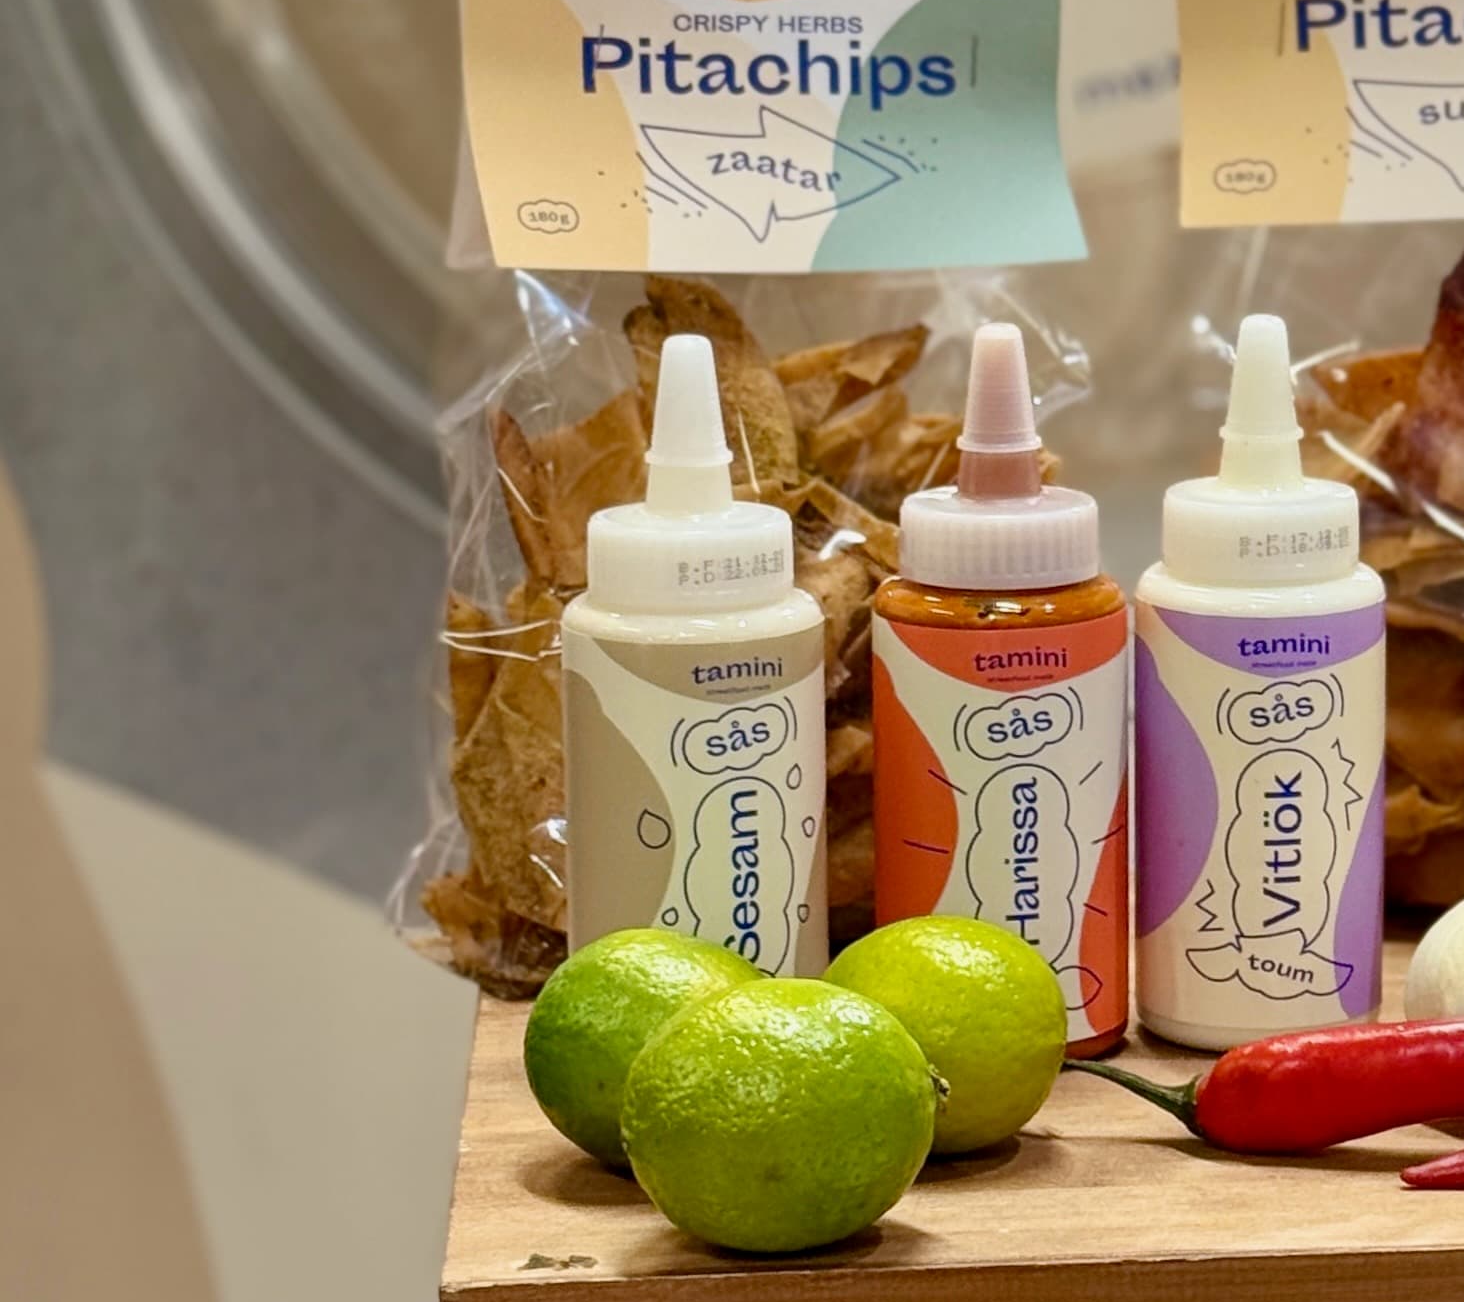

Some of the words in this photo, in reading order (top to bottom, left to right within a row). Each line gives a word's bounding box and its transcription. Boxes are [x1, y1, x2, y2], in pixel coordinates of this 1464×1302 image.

[673, 14, 769, 35] CRISPY
[778, 15, 864, 34] HERBS
[581, 36, 957, 111] Pitachips
[705, 145, 842, 194] zaatar
[974, 645, 1068, 672] tamini
[1237, 632, 1331, 657] tamini
[690, 656, 784, 685] tamini
[986, 708, 1054, 743] sås
[1249, 694, 1315, 728] sås
[706, 719, 771, 757] sås
[1003, 775, 1041, 947] Harissa
[1261, 770, 1304, 929] Vitlök
[723, 789, 761, 965] Sesam
[1247, 951, 1315, 984] toum
